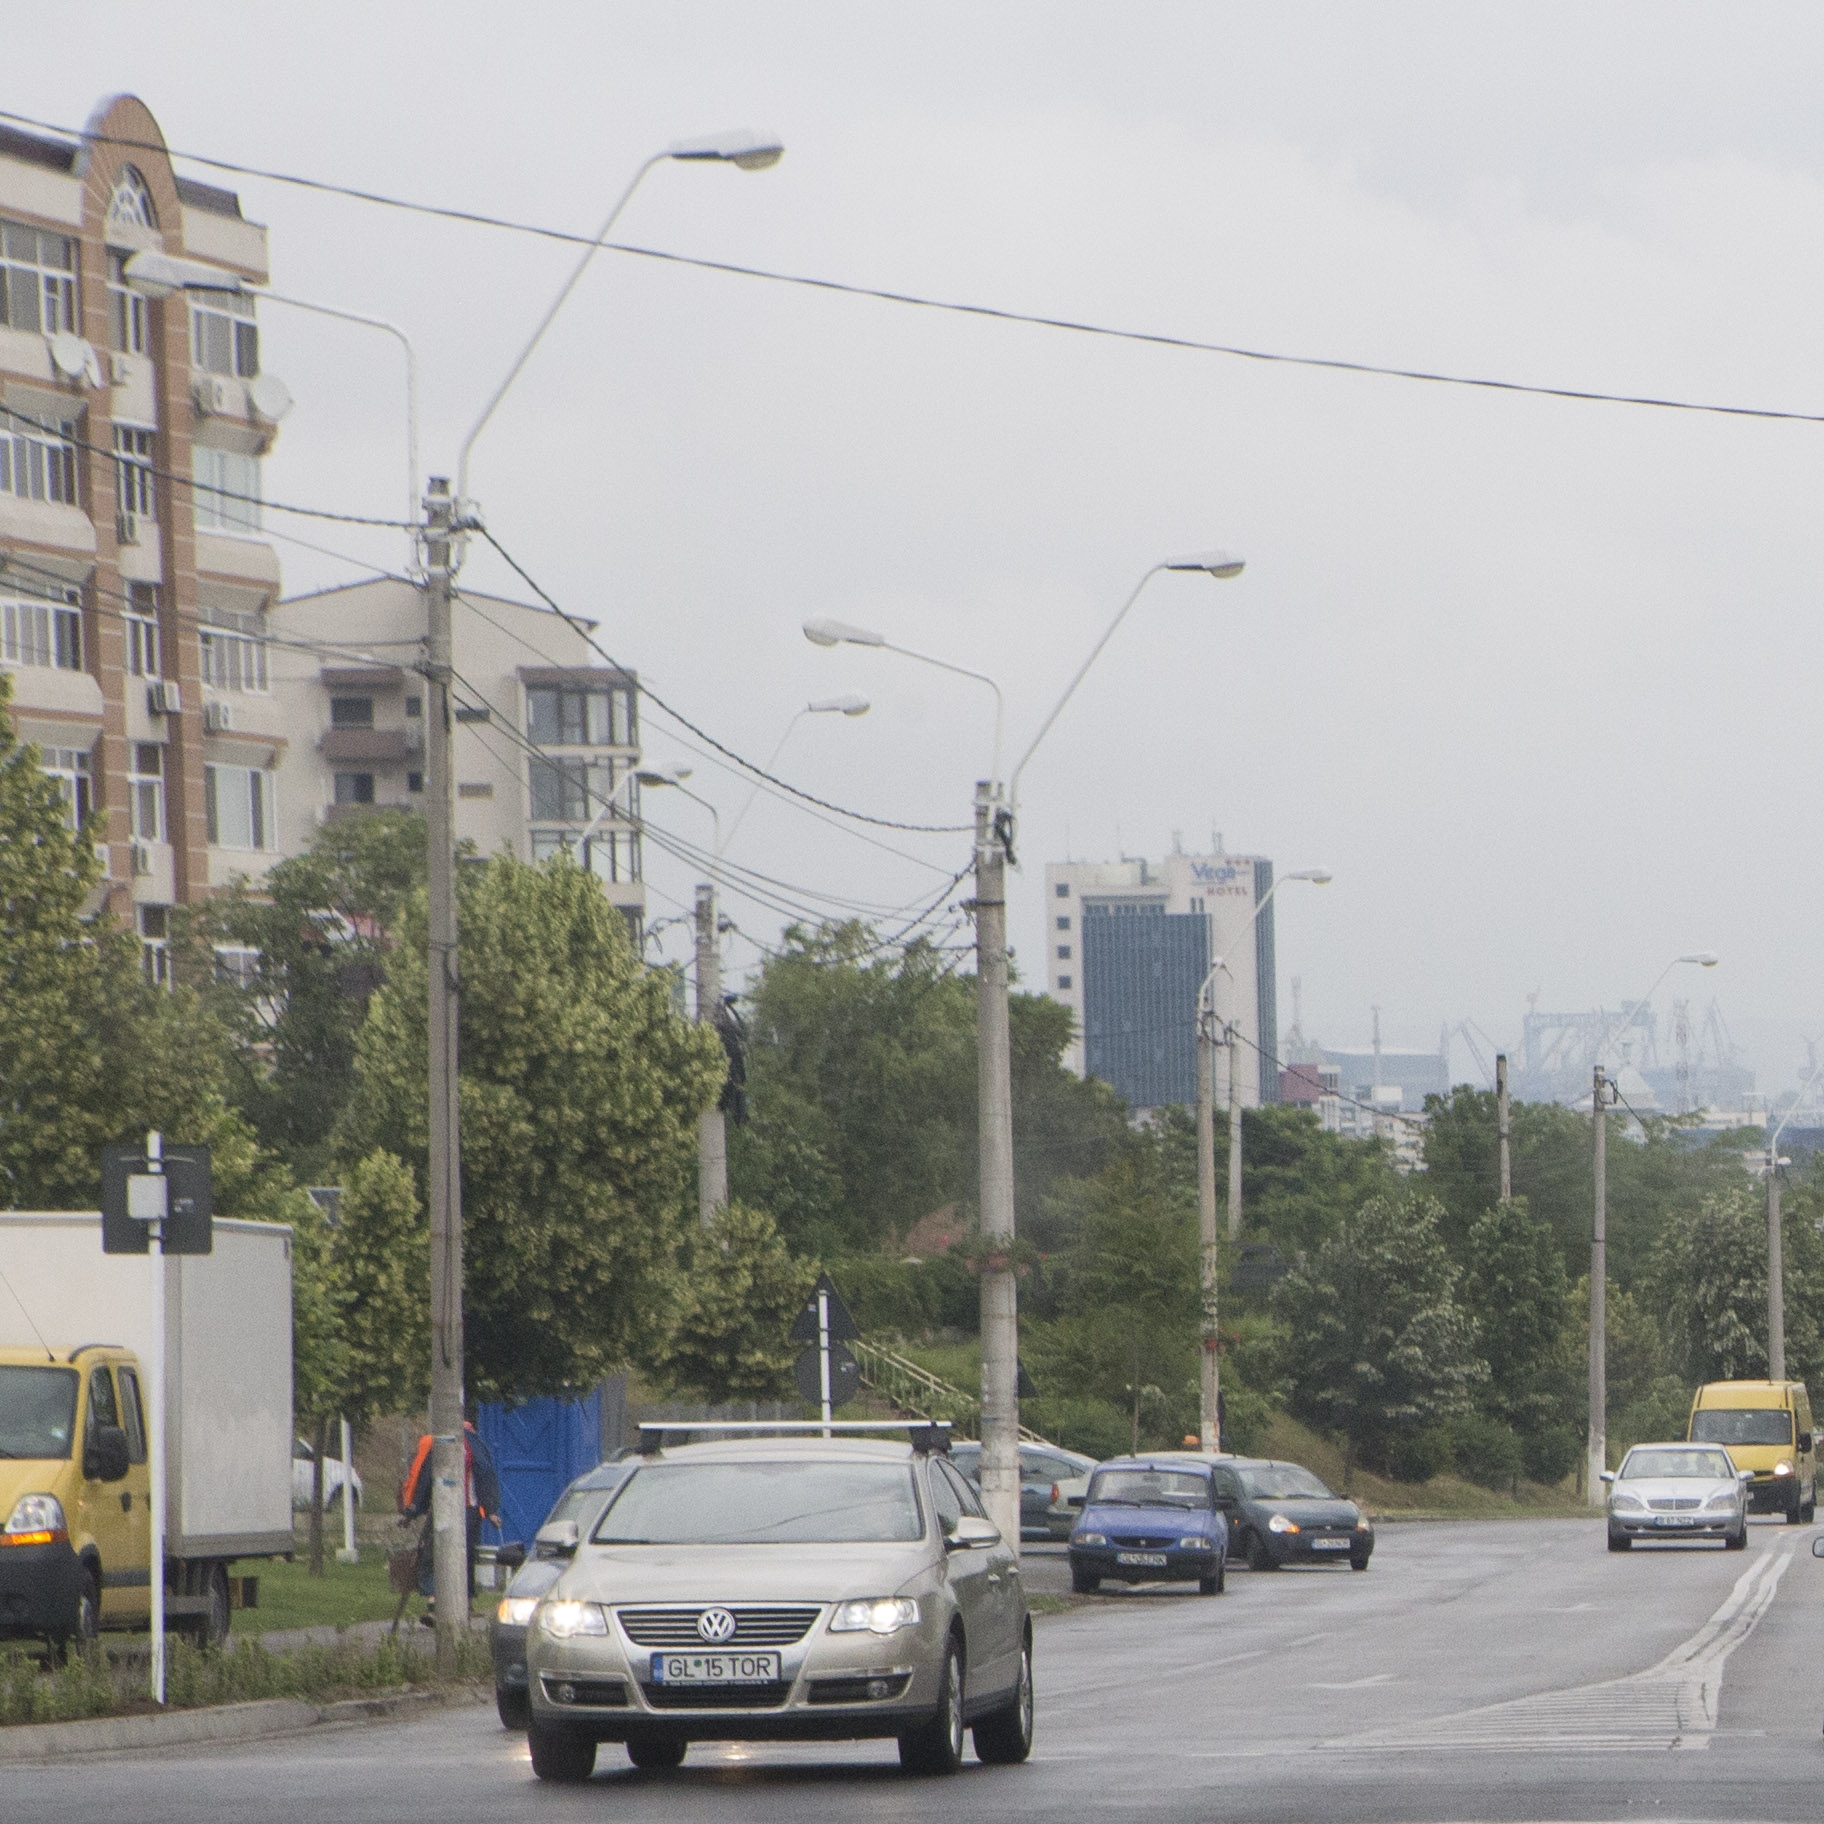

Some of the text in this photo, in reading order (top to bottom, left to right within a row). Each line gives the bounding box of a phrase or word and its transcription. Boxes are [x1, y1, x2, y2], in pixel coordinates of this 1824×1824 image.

[1207, 887, 1248, 896] HOTEL
[668, 1657, 771, 1678] GL 15 TOR
